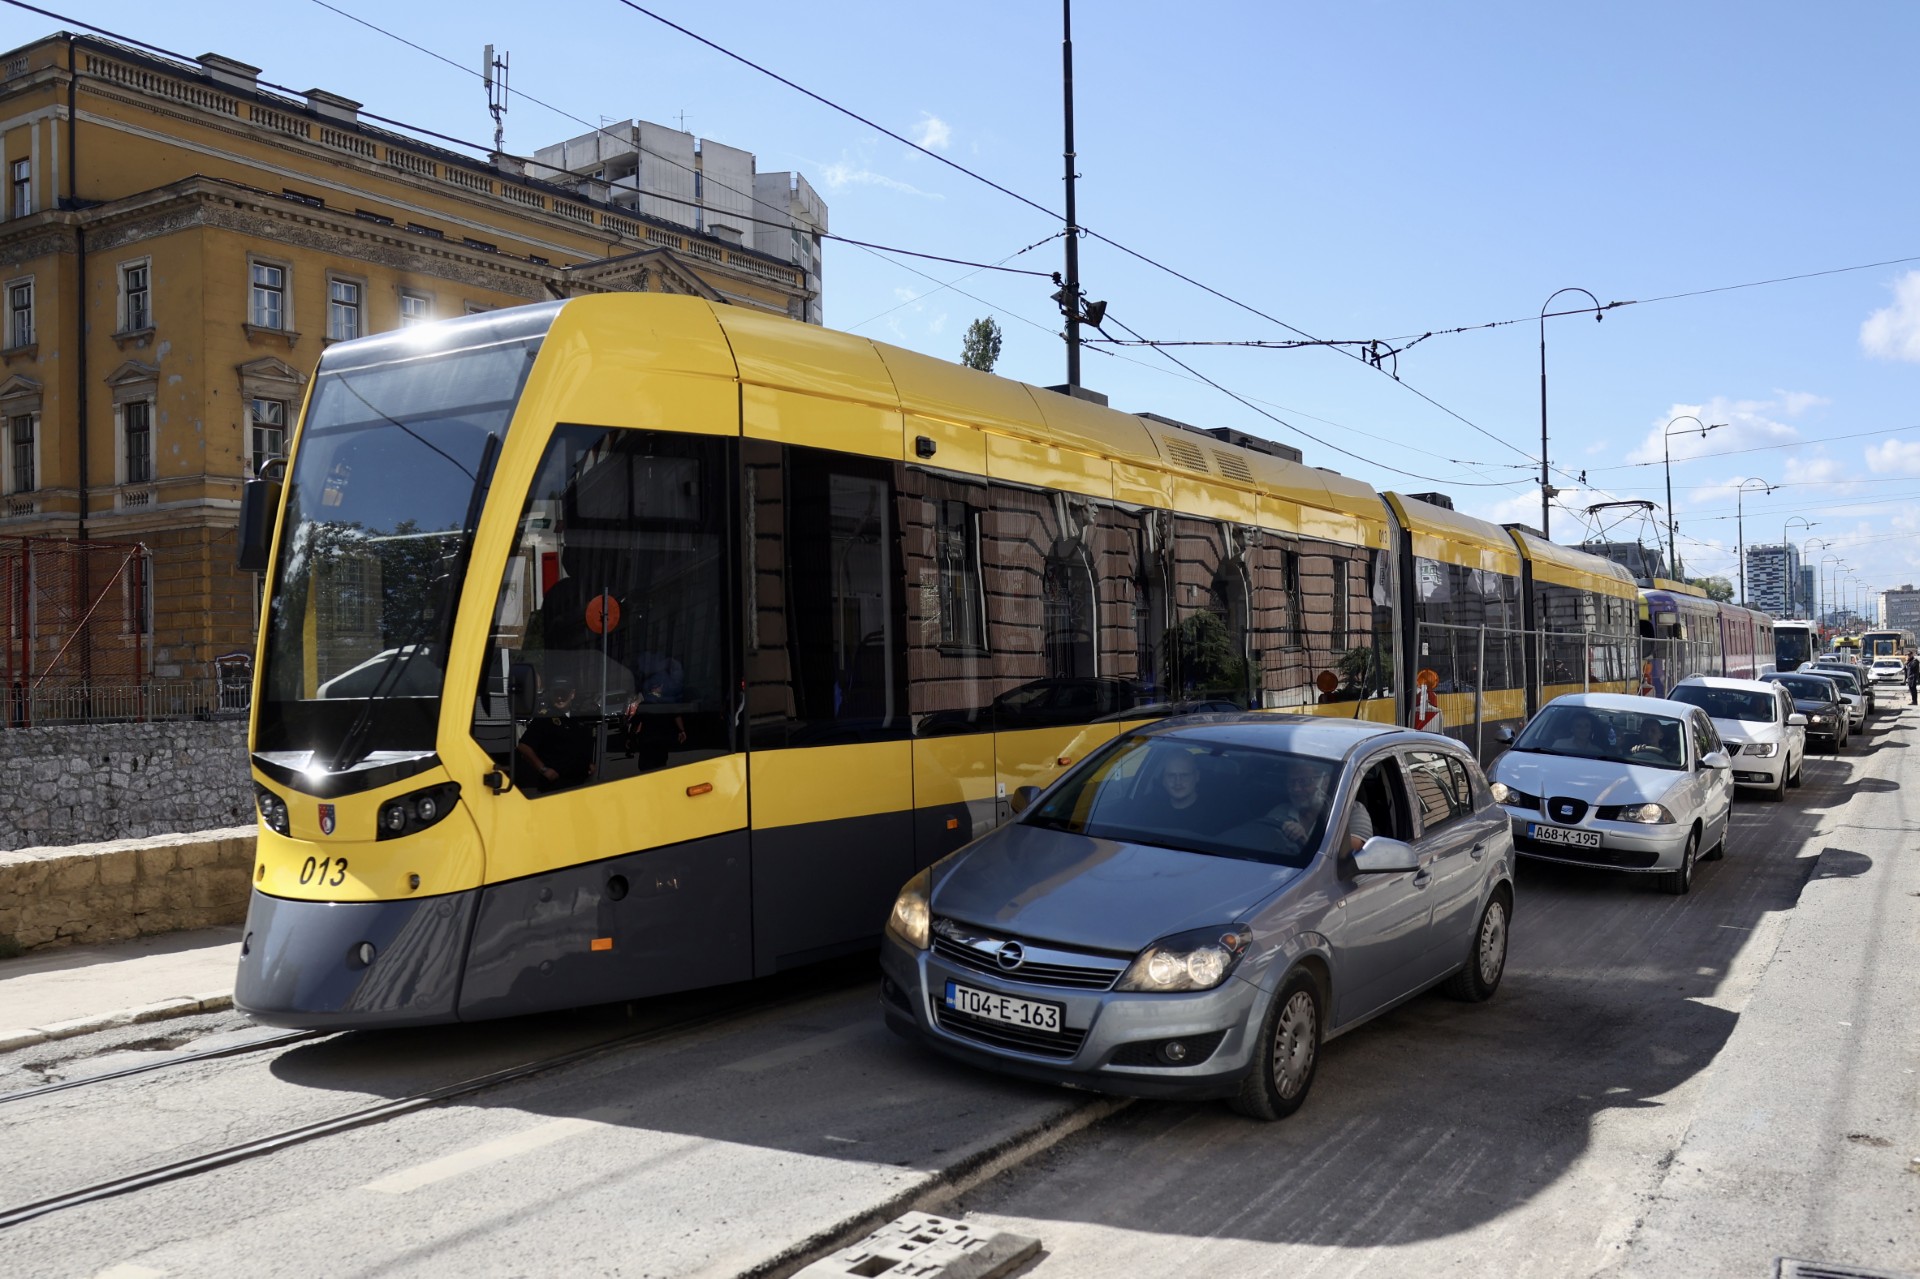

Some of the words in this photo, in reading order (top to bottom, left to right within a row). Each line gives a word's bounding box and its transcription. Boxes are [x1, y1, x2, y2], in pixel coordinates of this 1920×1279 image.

[1535, 827, 1598, 846] A68-K-195
[299, 856, 348, 887] 013
[958, 988, 1057, 1028] T04-E-163
